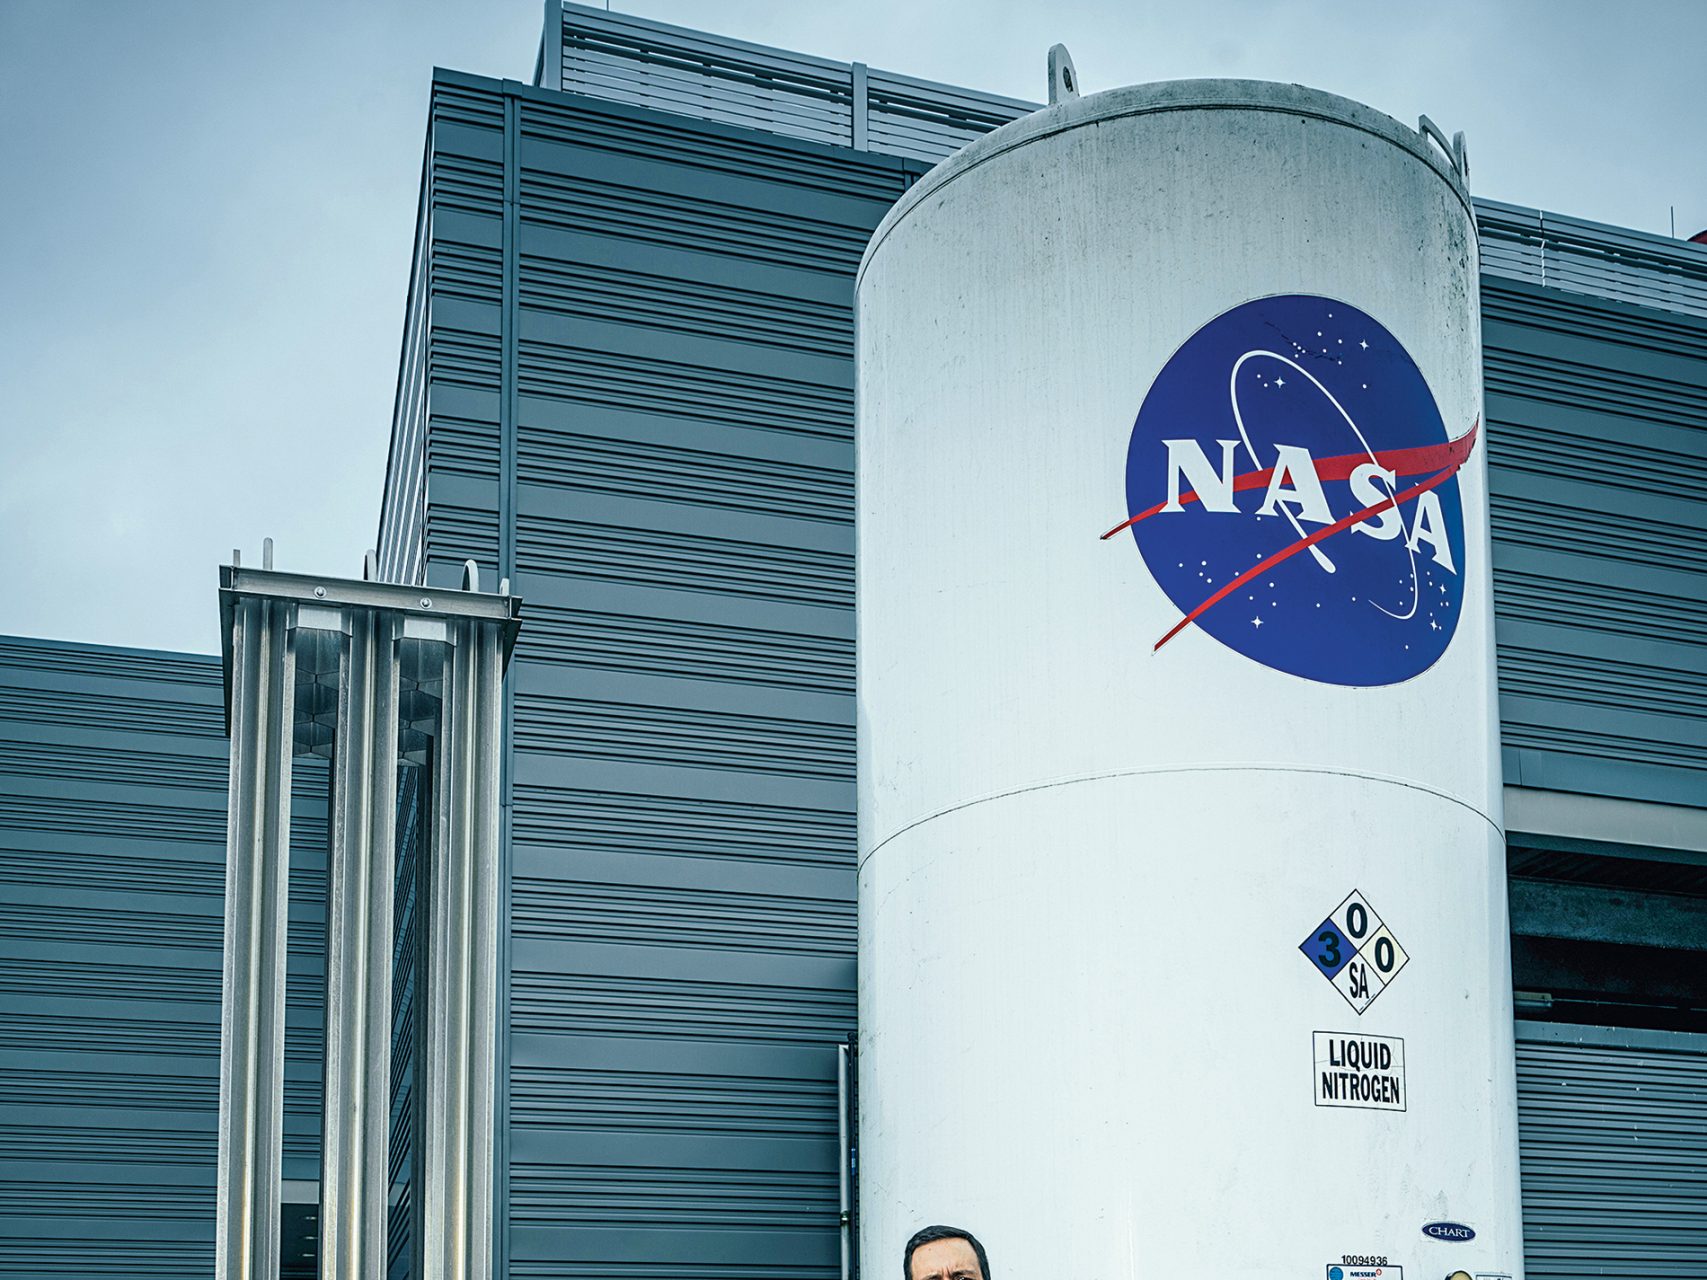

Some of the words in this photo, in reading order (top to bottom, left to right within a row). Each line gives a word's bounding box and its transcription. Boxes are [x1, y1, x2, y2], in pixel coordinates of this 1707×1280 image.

[1161, 439, 1457, 575] NASA
[1346, 902, 1368, 939] 0
[1318, 931, 1341, 968] 3
[1374, 936, 1394, 973] 0
[1349, 962, 1370, 999] SA
[1329, 1039, 1391, 1072] LIQUID
[1322, 1071, 1400, 1104] NITROGEN
[1428, 1226, 1470, 1239] CHART
[1341, 1255, 1388, 1266] 10094936
